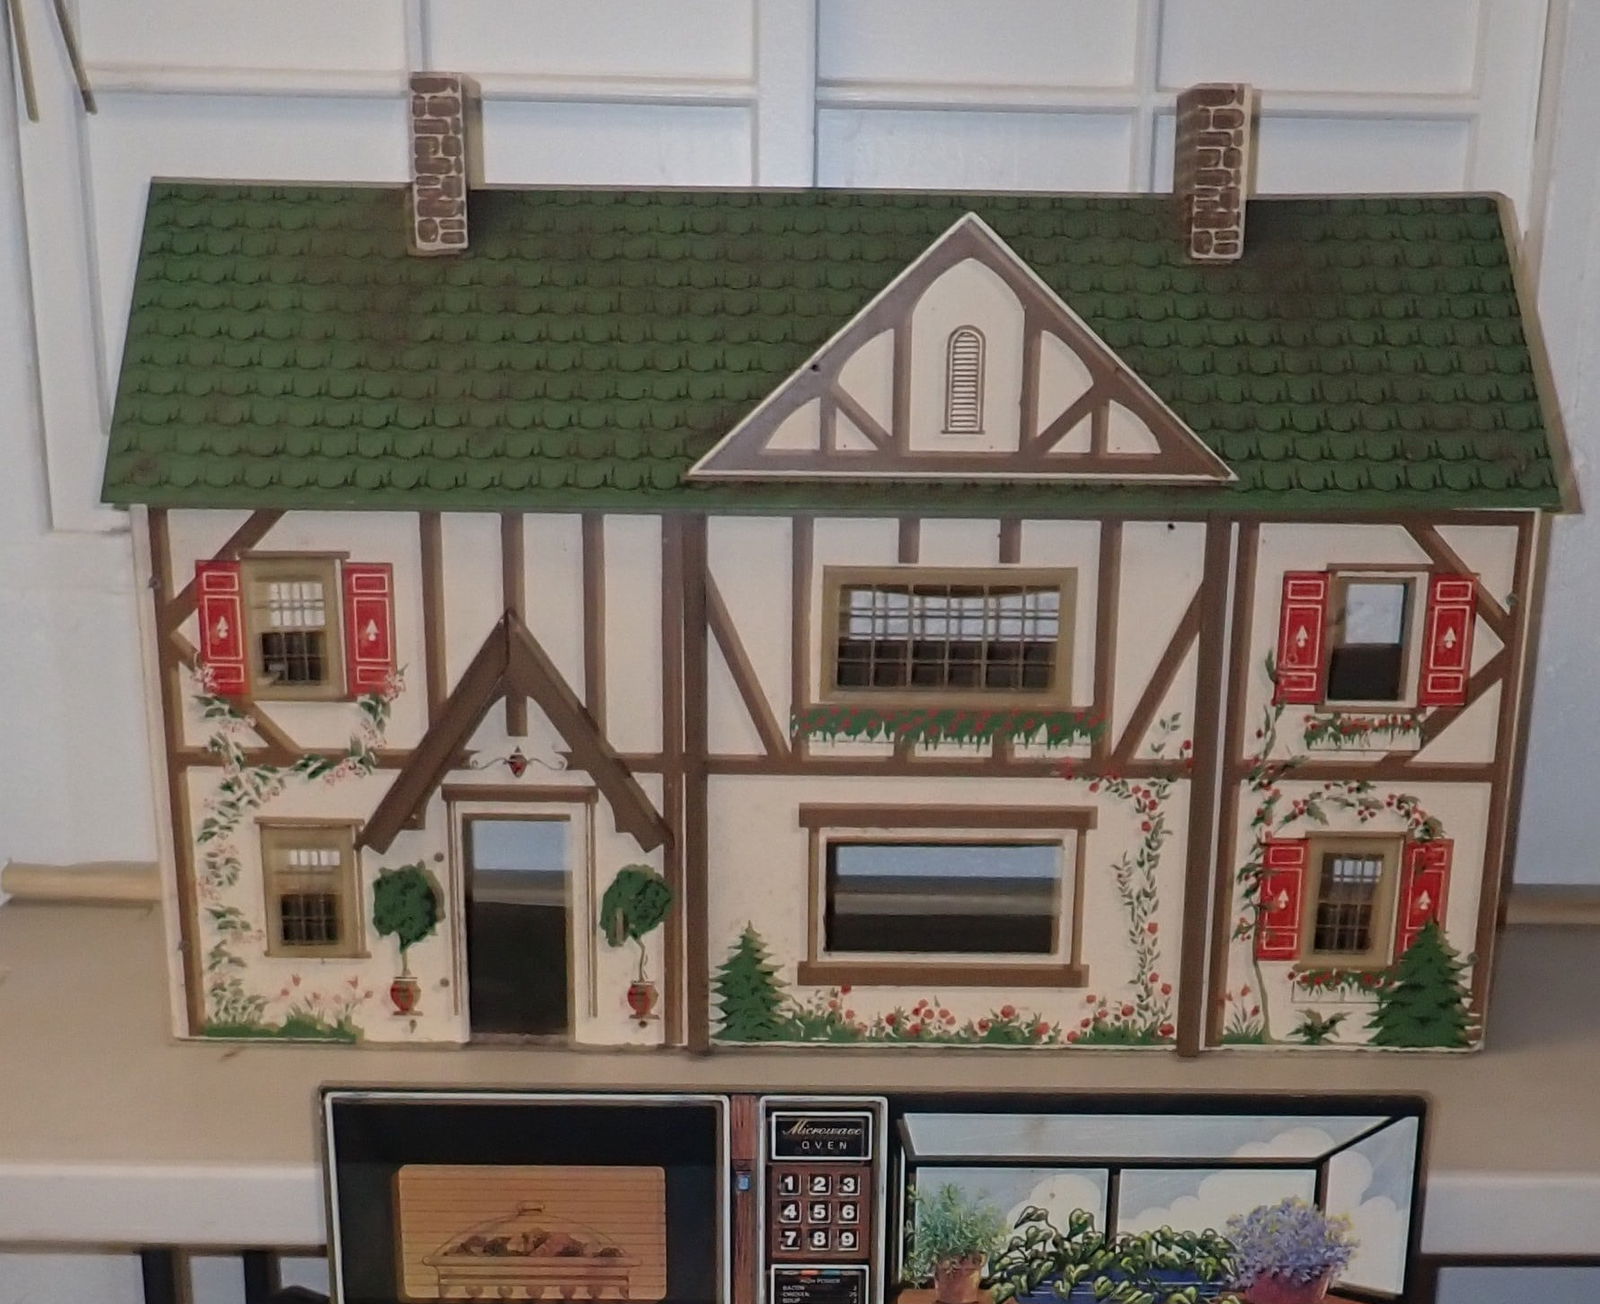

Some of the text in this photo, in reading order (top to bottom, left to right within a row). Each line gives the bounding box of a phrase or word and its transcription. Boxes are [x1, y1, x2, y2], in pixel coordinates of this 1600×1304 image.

[782, 1118, 863, 1135] Microwave
[801, 1140, 847, 1150] OVEN
[784, 1175, 855, 1192] 1 2 3
[783, 1204, 855, 1219] 4 5 6
[784, 1231, 854, 1246] 7 8 9
